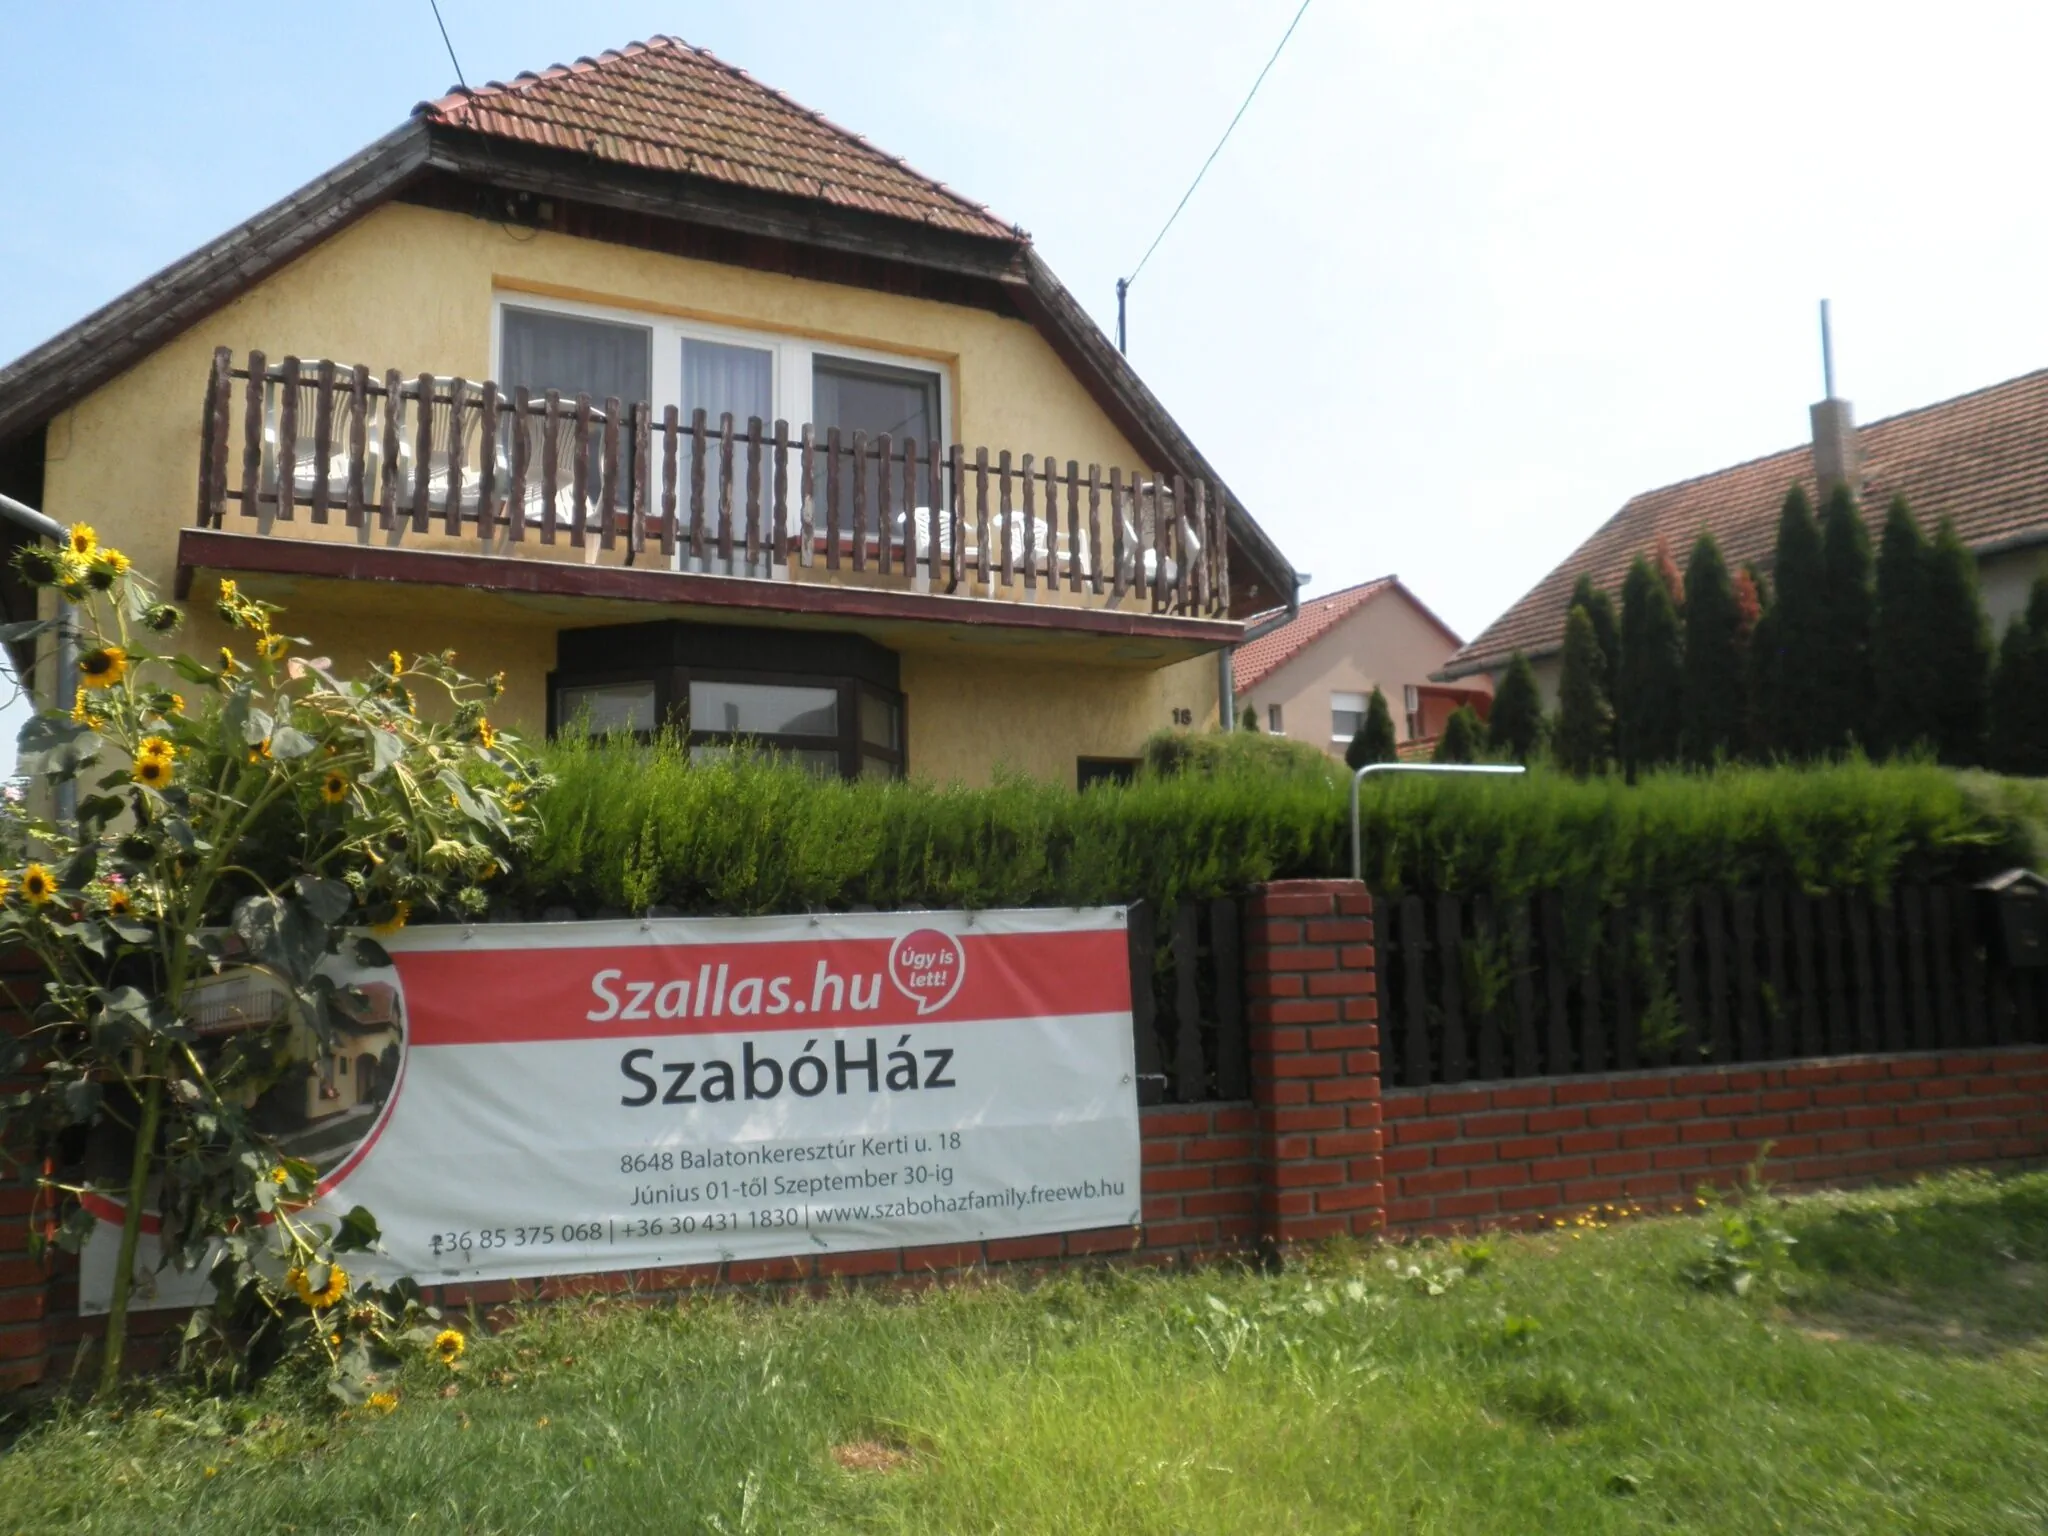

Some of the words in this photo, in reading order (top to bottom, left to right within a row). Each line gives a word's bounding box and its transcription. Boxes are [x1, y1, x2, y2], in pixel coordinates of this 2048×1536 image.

[901, 946, 937, 969] Úgy
[939, 948, 954, 965] is
[909, 970, 948, 988] lett!
[585, 959, 883, 1022] Szallas.hu
[619, 1033, 957, 1108] SzabóHáz
[620, 1152, 674, 1174] 8648
[681, 1141, 856, 1170] Balatonkeresztúr
[862, 1135, 909, 1157] Kerti
[914, 1138, 932, 1152] u.
[938, 1132, 962, 1151] 18
[630, 1184, 701, 1207] Június
[705, 1177, 768, 1201] 01-től
[774, 1168, 898, 1196] Szeptember
[903, 1164, 954, 1186] 30-ig
[479, 1228, 507, 1250] 85
[513, 1225, 555, 1246] 375
[561, 1221, 603, 1243] 068
[621, 1216, 664, 1238] +36
[669, 1215, 696, 1235] 30
[701, 1212, 738, 1232] 431
[749, 1207, 799, 1229] 1830
[815, 1178, 1124, 1222] www.szabohazfamily.freewb.hu
